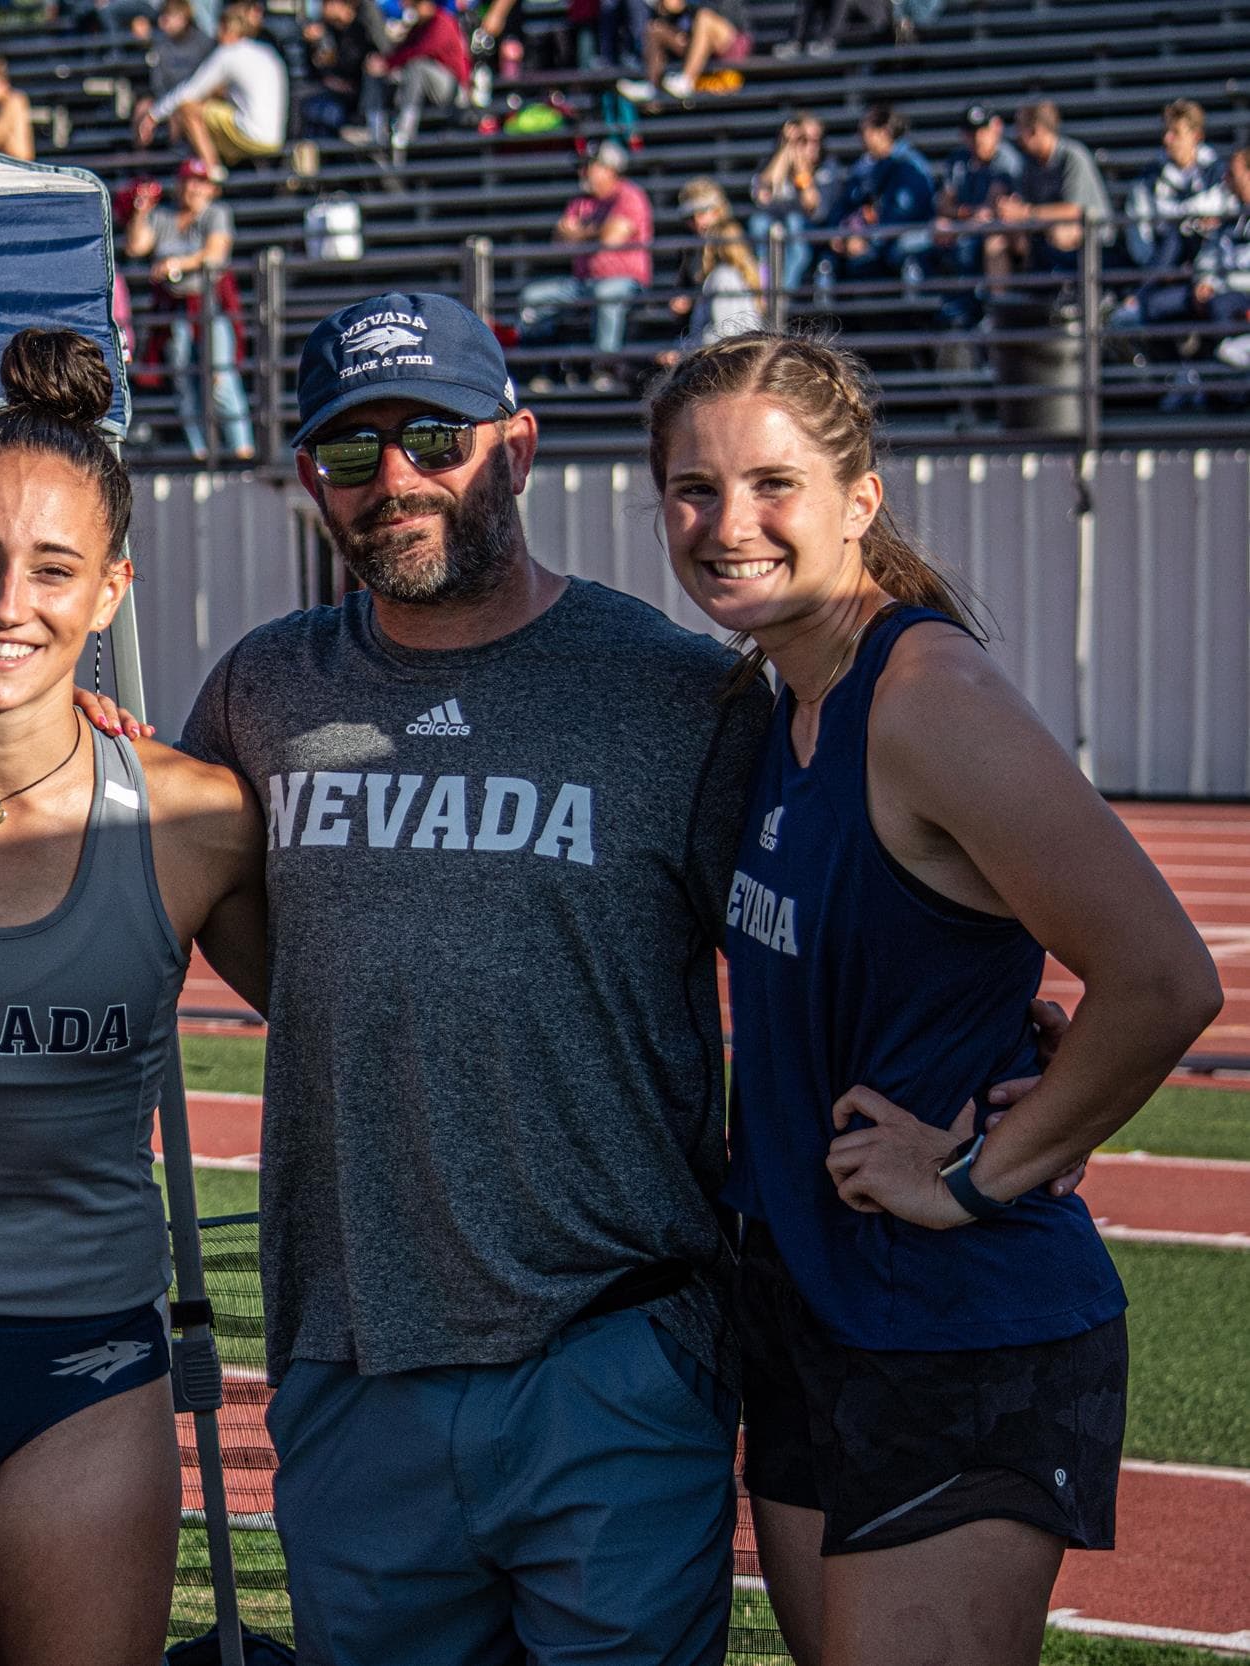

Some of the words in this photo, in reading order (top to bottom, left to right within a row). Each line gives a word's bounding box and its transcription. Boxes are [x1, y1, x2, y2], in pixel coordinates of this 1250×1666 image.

[340, 312, 428, 345] NEVADA
[339, 360, 378, 379] TRACK
[382, 357, 393, 367] &
[396, 355, 433, 365] FIELD
[406, 721, 471, 736] adidas
[268, 771, 595, 866] NEVADA
[726, 869, 798, 957] EVADA
